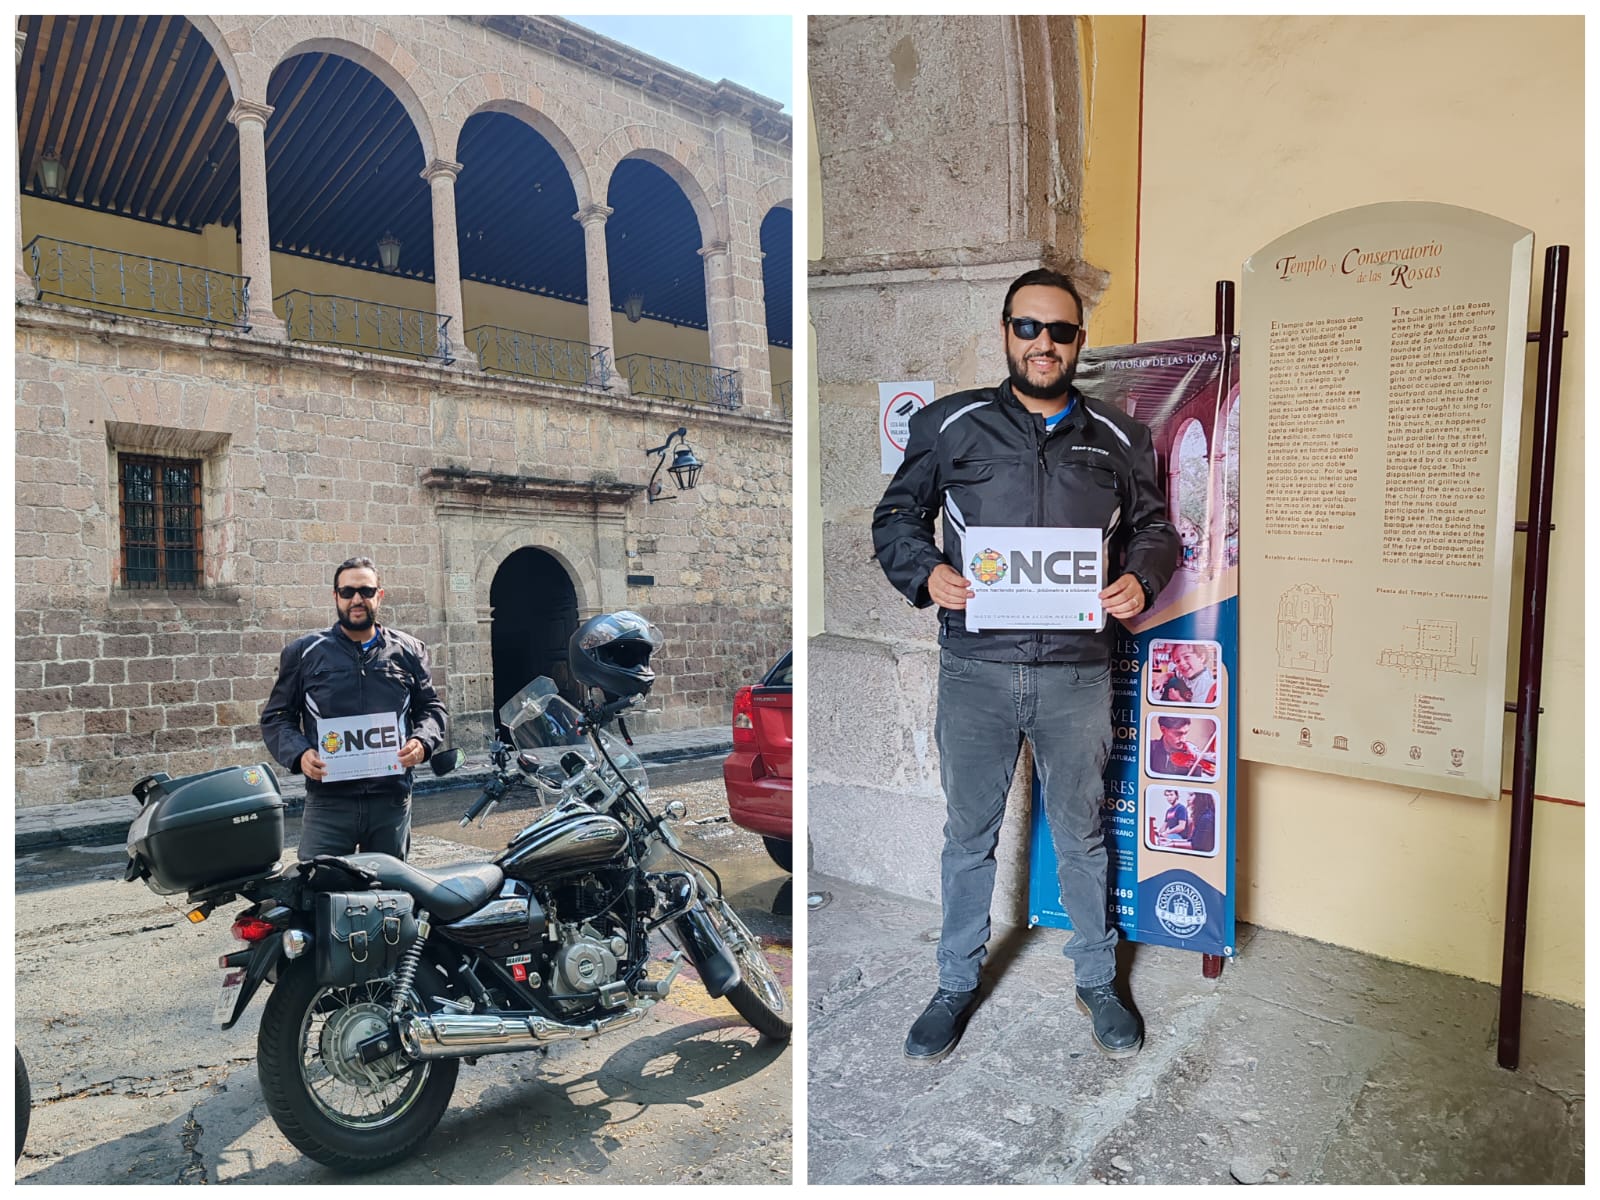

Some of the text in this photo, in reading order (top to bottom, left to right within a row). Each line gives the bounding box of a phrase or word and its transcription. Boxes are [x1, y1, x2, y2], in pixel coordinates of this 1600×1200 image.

[1276, 240, 1443, 280] Templo y Conservatorio
[1357, 264, 1442, 289] de las Rosas
[1152, 358, 1166, 367] DE
[1168, 356, 1184, 365] LAS
